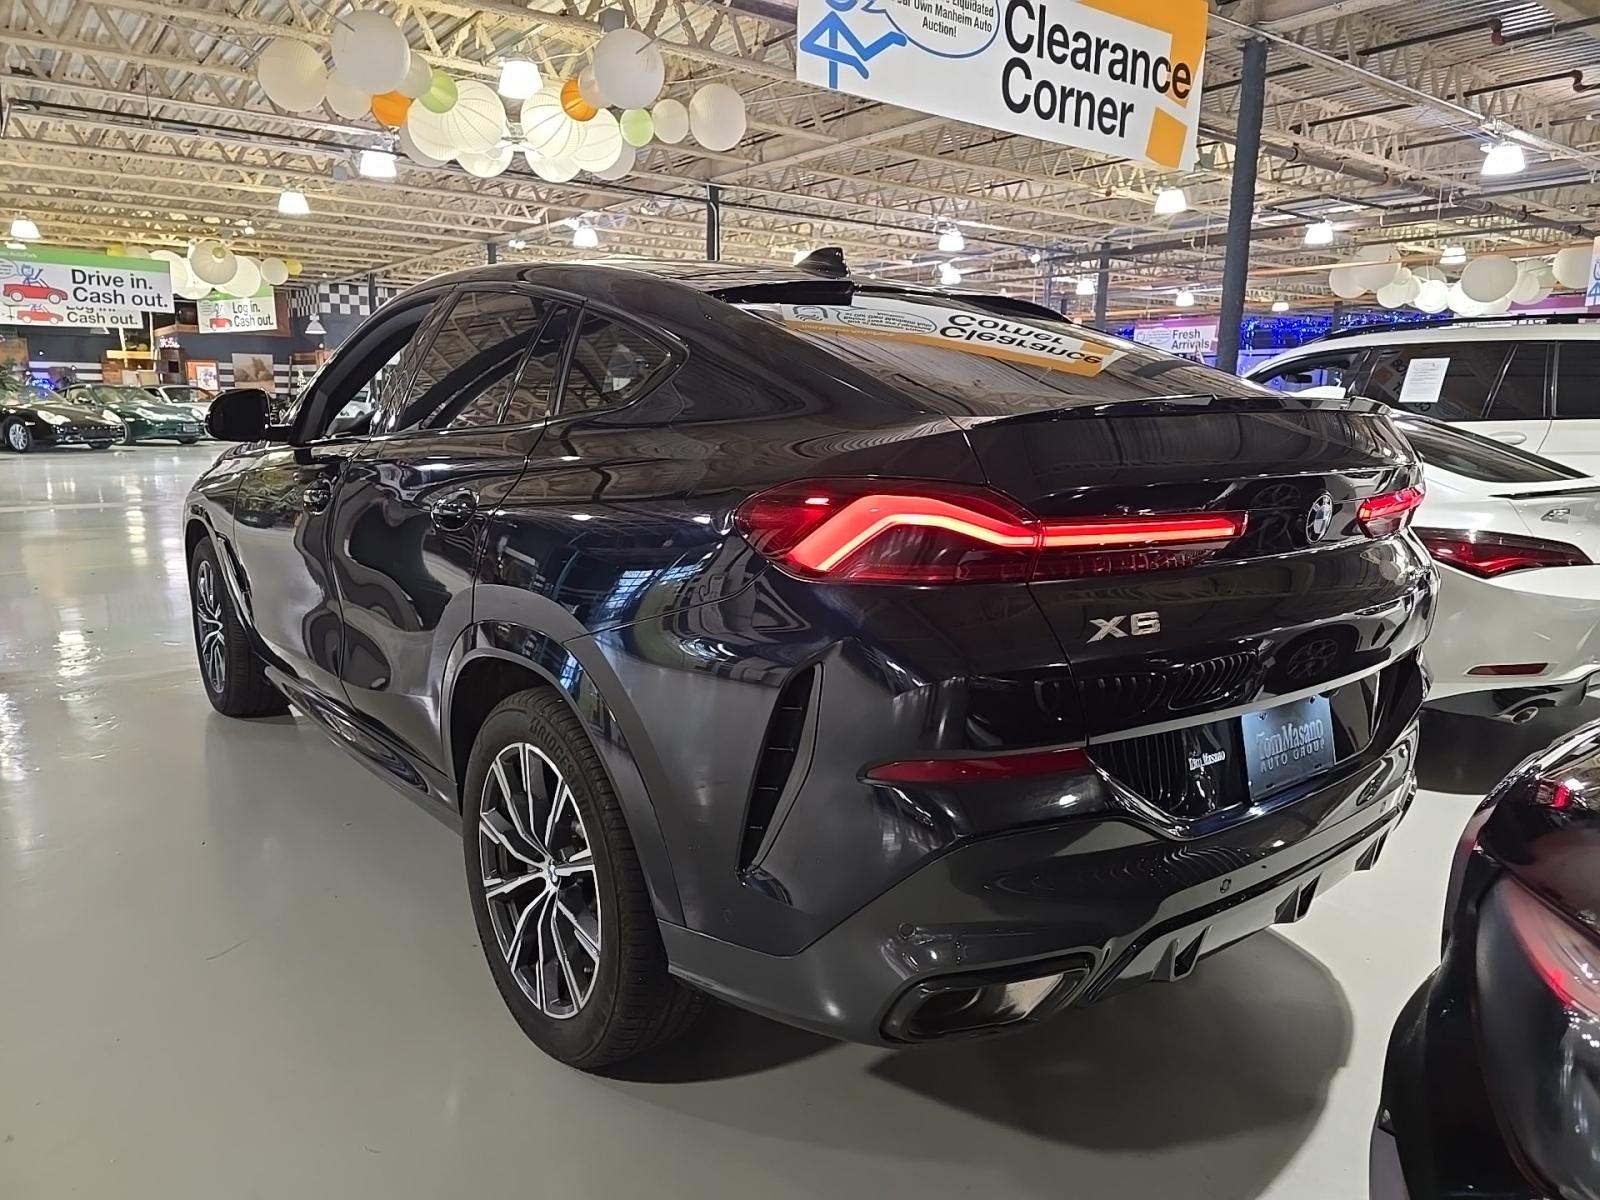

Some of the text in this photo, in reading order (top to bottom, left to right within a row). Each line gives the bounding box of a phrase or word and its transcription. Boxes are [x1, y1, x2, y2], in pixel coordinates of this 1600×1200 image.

[914, 0, 932, 13] Own
[935, 4, 972, 26] Manheim
[973, 17, 992, 32] Auto
[922, 16, 957, 37] Auction!
[1004, 0, 1191, 99] Clearance
[1002, 57, 1134, 138] Corner
[71, 268, 153, 290] Drive in.
[73, 287, 168, 308] Cash out.
[232, 300, 261, 316] Log in.
[66, 312, 138, 325] Cash out.
[234, 315, 274, 327] Cash out.
[1172, 329, 1200, 339] Fresh
[1171, 340, 1210, 350] Arrivals
[1086, 611, 1160, 643] X6
[1260, 738, 1326, 774] AUTO GROUP
